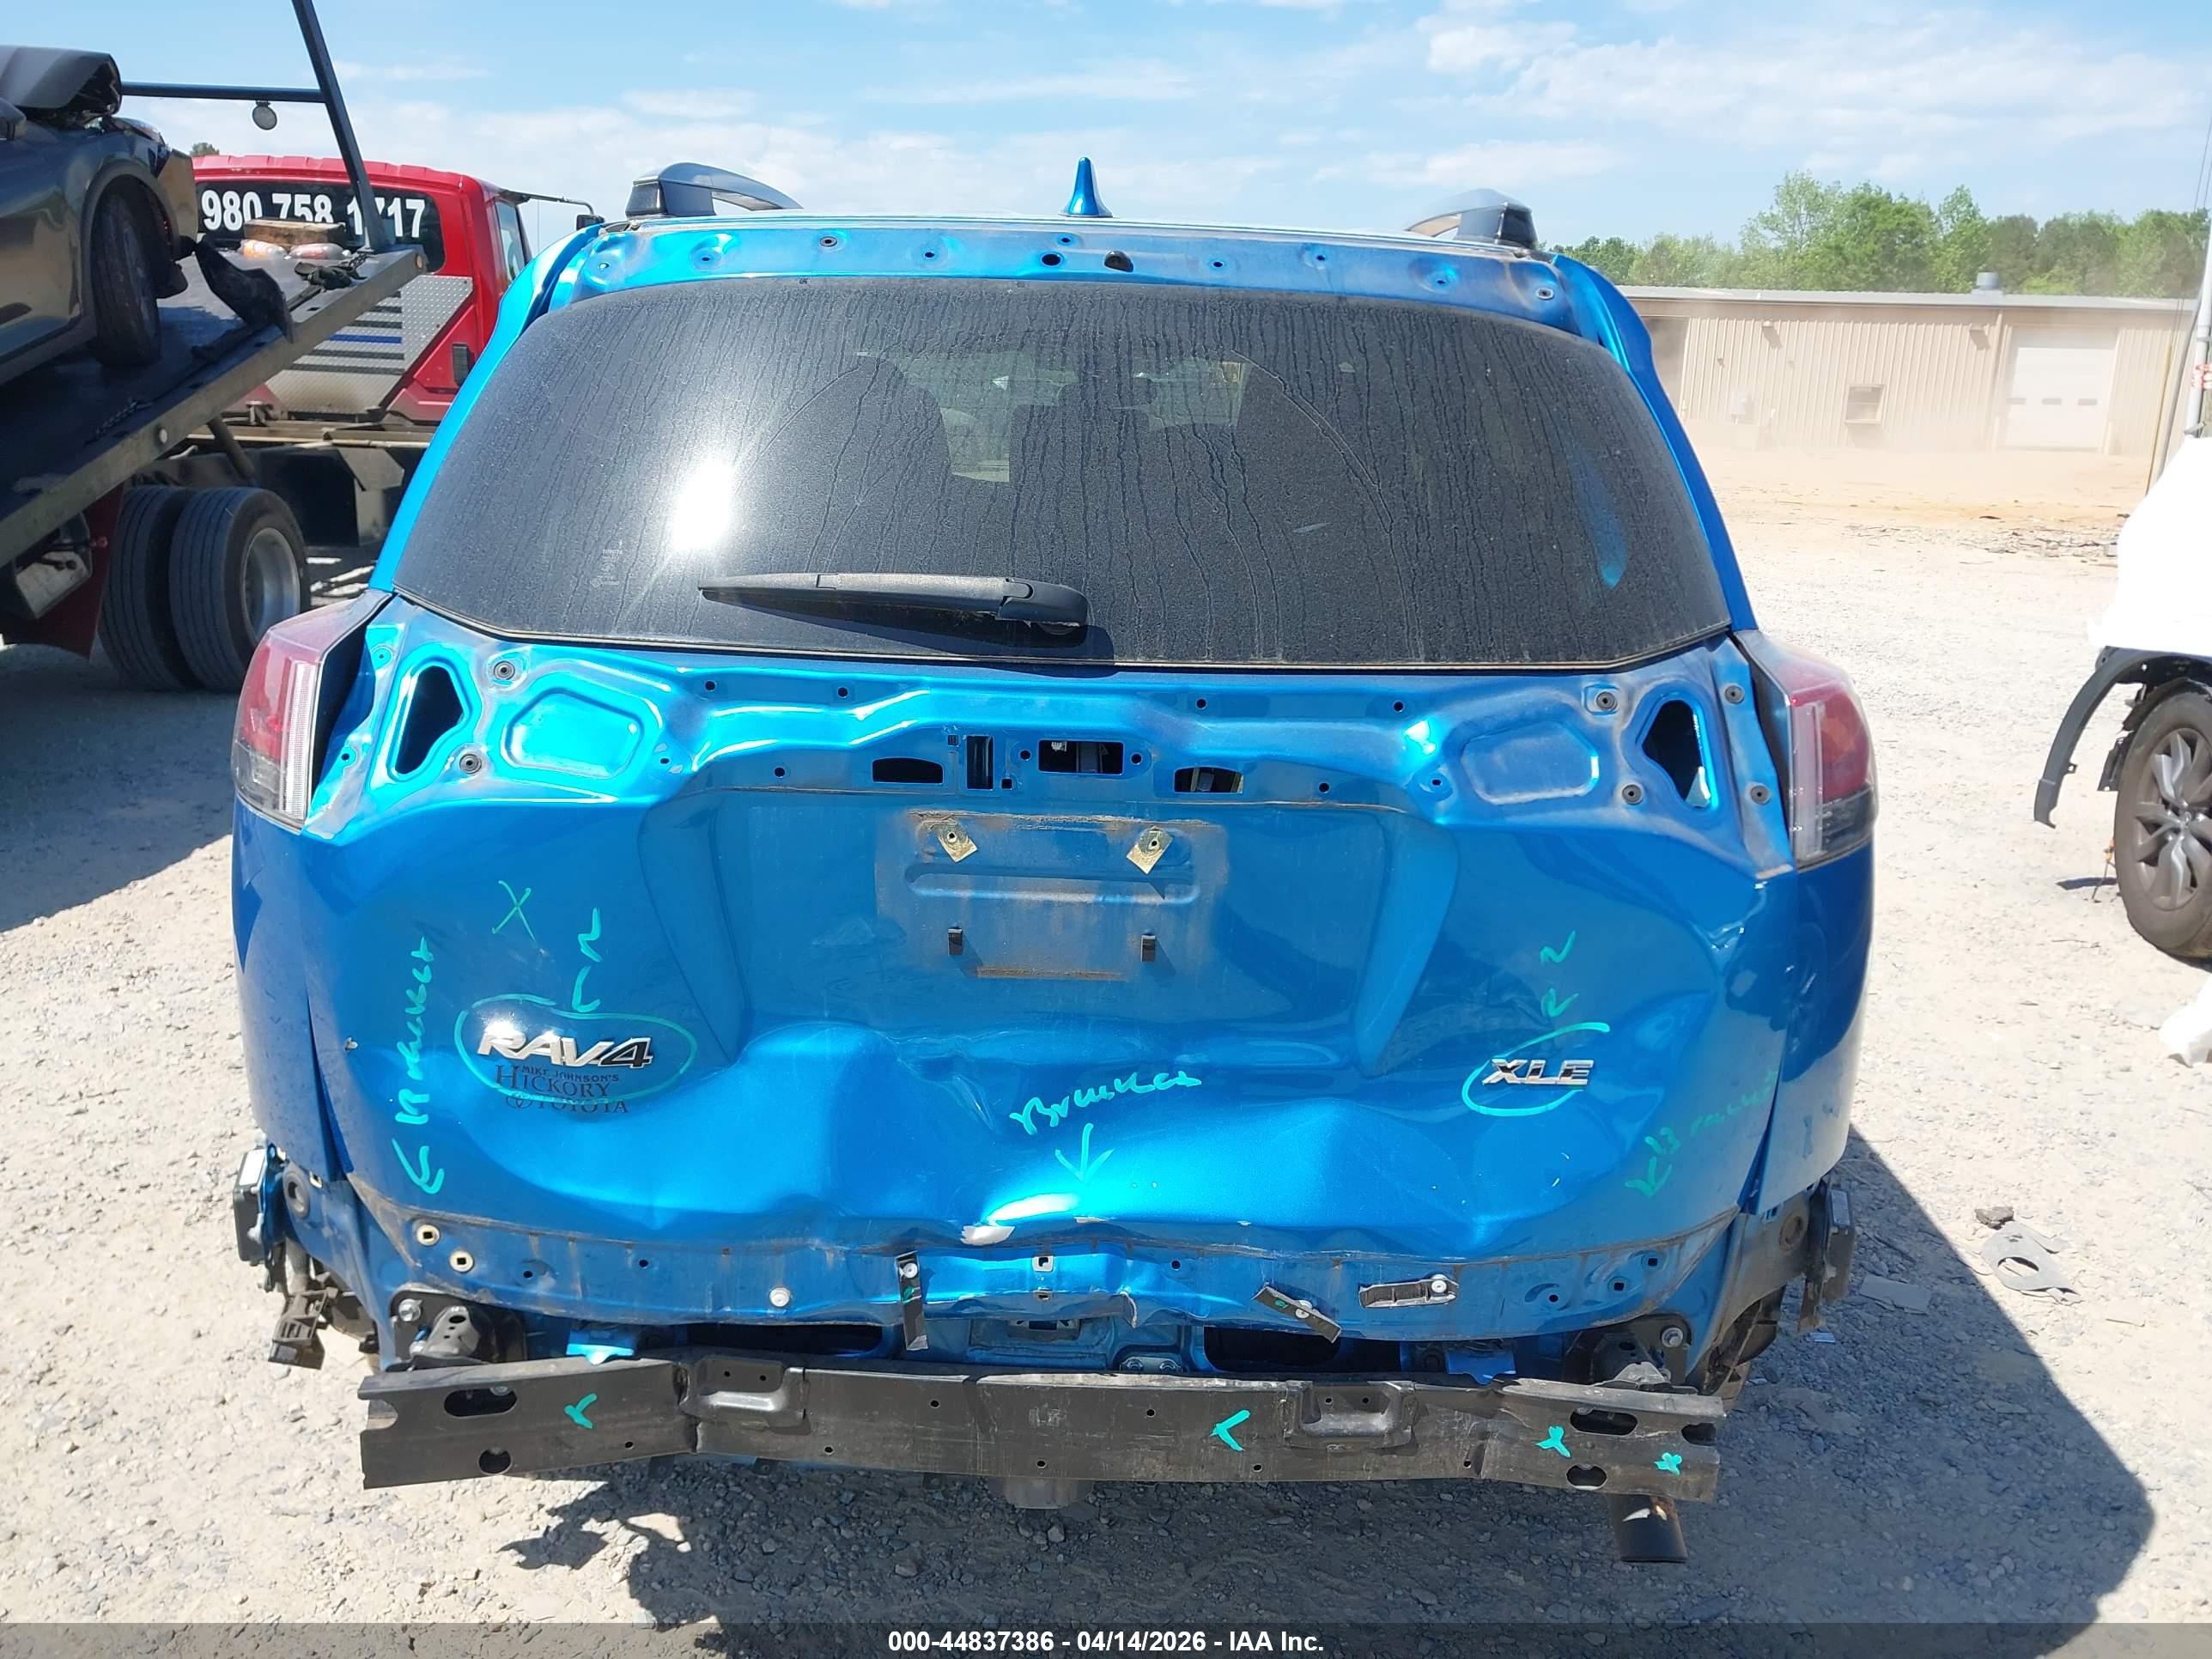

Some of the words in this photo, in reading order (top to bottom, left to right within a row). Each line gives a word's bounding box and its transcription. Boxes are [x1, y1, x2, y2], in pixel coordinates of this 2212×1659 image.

[201, 190, 263, 231] 980
[272, 193, 334, 223] 758
[347, 197, 425, 238] 117
[477, 1027, 653, 1068] RAV4
[495, 1064, 611, 1097] HICKORY
[1481, 1058, 1595, 1086] XLE
